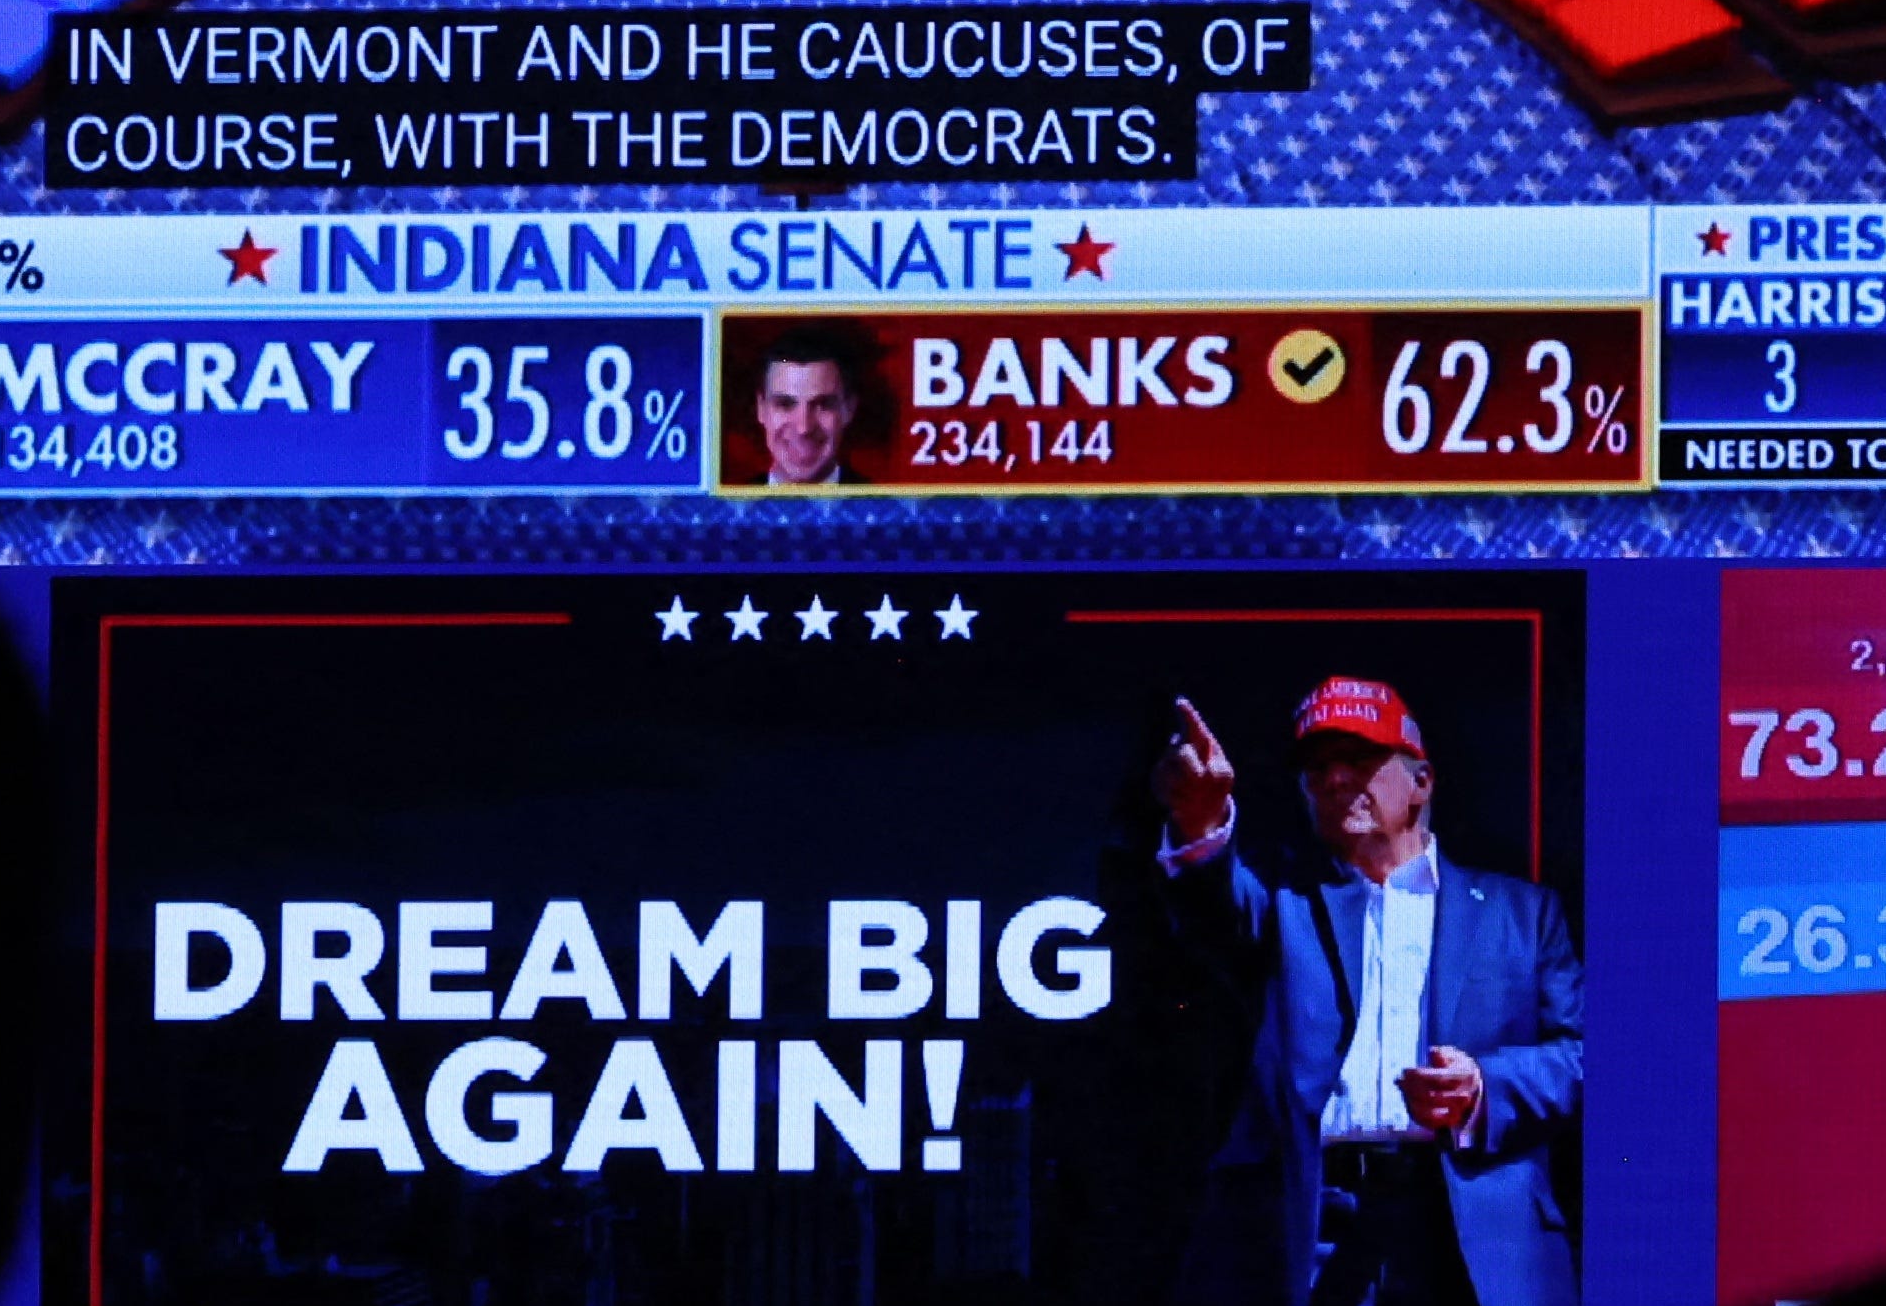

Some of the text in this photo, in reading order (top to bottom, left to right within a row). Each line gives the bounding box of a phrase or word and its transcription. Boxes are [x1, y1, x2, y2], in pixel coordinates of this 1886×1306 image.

[69, 19, 1288, 84] IN VERMONT AND HE CAUCUSES, OF
[68, 108, 1175, 179] COURSE, WITH THE DEMOCRATS.
[300, 220, 1035, 293] INDIANA SENATE
[1670, 281, 1886, 326] HARRIS
[444, 344, 685, 461] 35.8%
[911, 336, 1233, 408] BANKS
[1381, 340, 1627, 455] 62.3%
[1764, 341, 1798, 414] 3
[911, 420, 1112, 467] 234,144
[1686, 438, 1834, 471] NEEDED
[154, 897, 1112, 1022] DREAM BIG
[282, 1038, 964, 1174] AGAIN!
